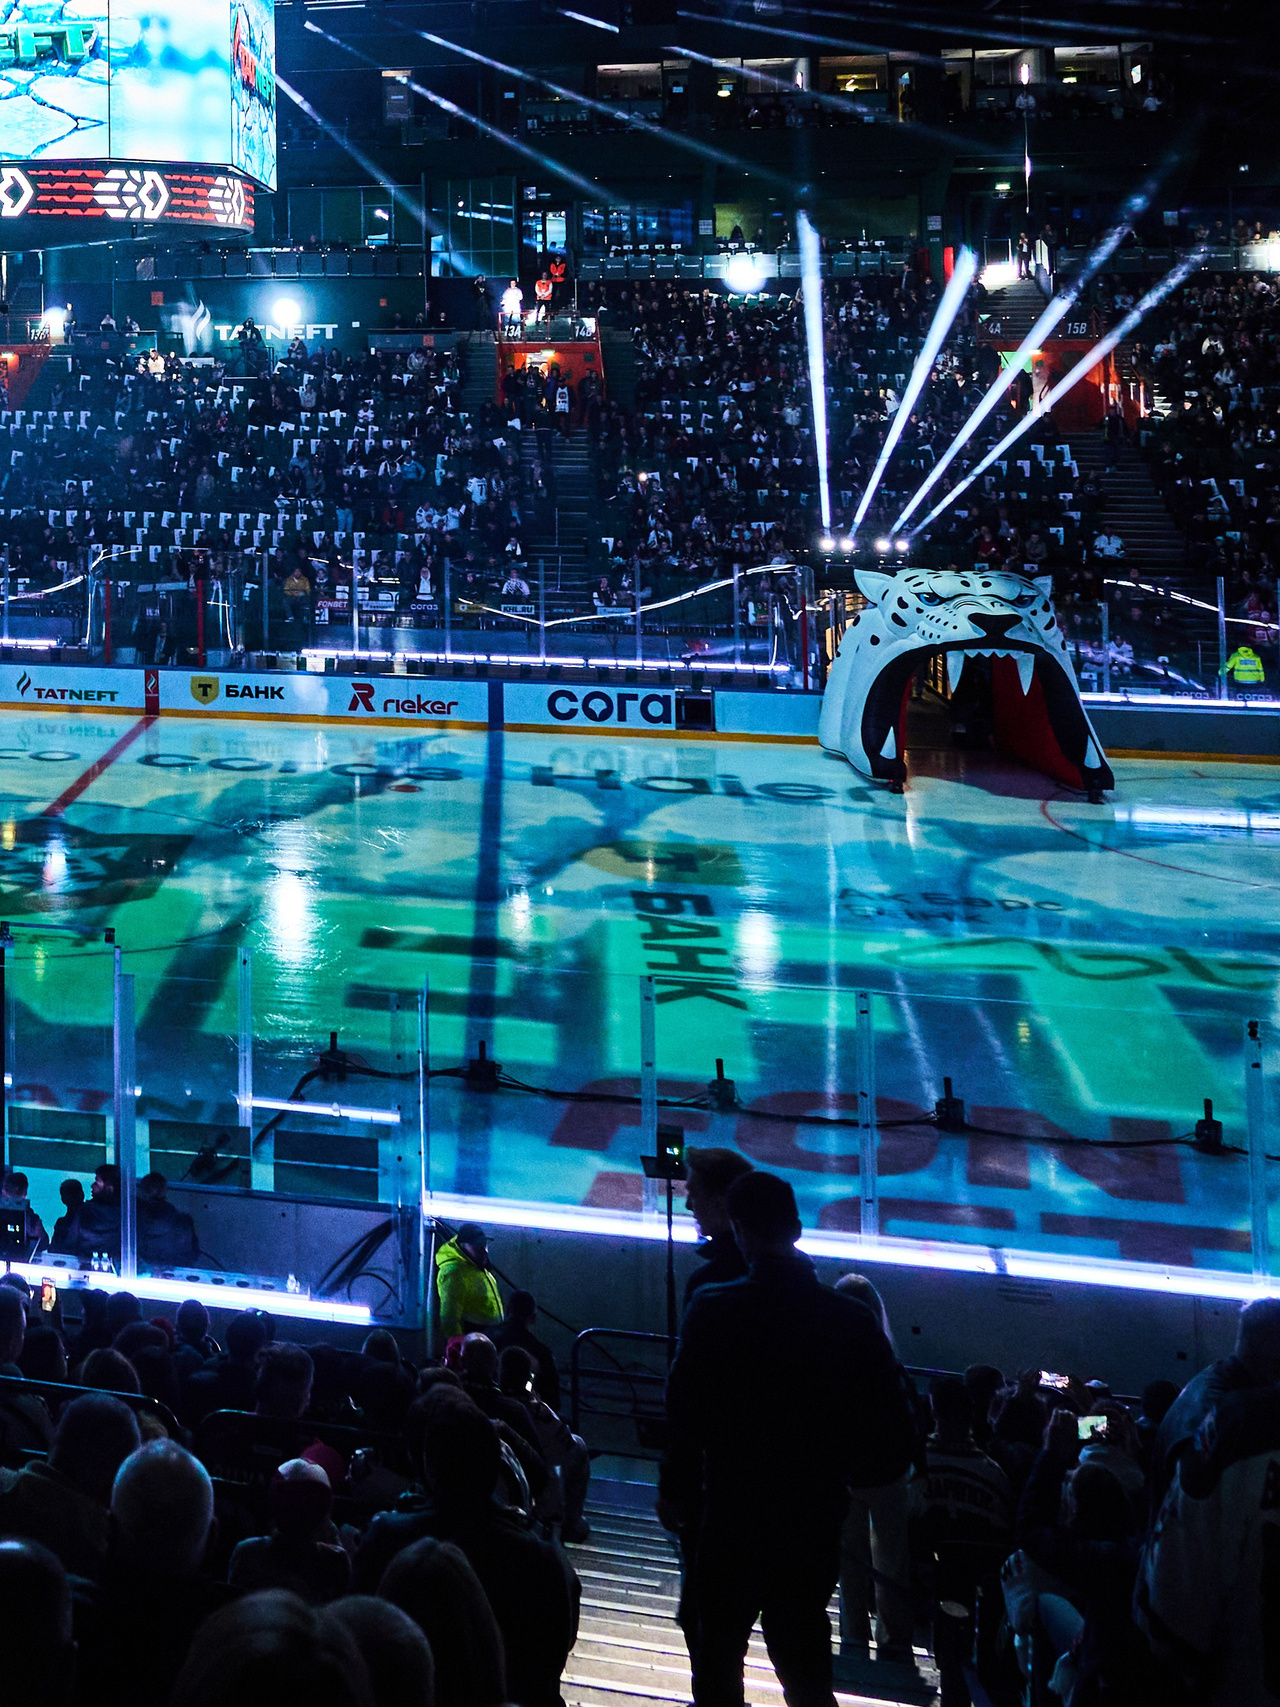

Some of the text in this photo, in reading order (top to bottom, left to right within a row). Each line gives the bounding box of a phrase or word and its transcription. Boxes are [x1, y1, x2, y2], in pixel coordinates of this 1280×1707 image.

[503, 325, 523, 338] 13A
[1066, 322, 1088, 335] 15B
[317, 600, 349, 609] FONBET
[502, 604, 535, 615] KHL.RU
[33, 687, 120, 702] TATNEFT
[225, 684, 285, 701] БАНК
[383, 694, 460, 715] rieker
[530, 765, 878, 803] Haier
[630, 890, 748, 1011] БАНК
